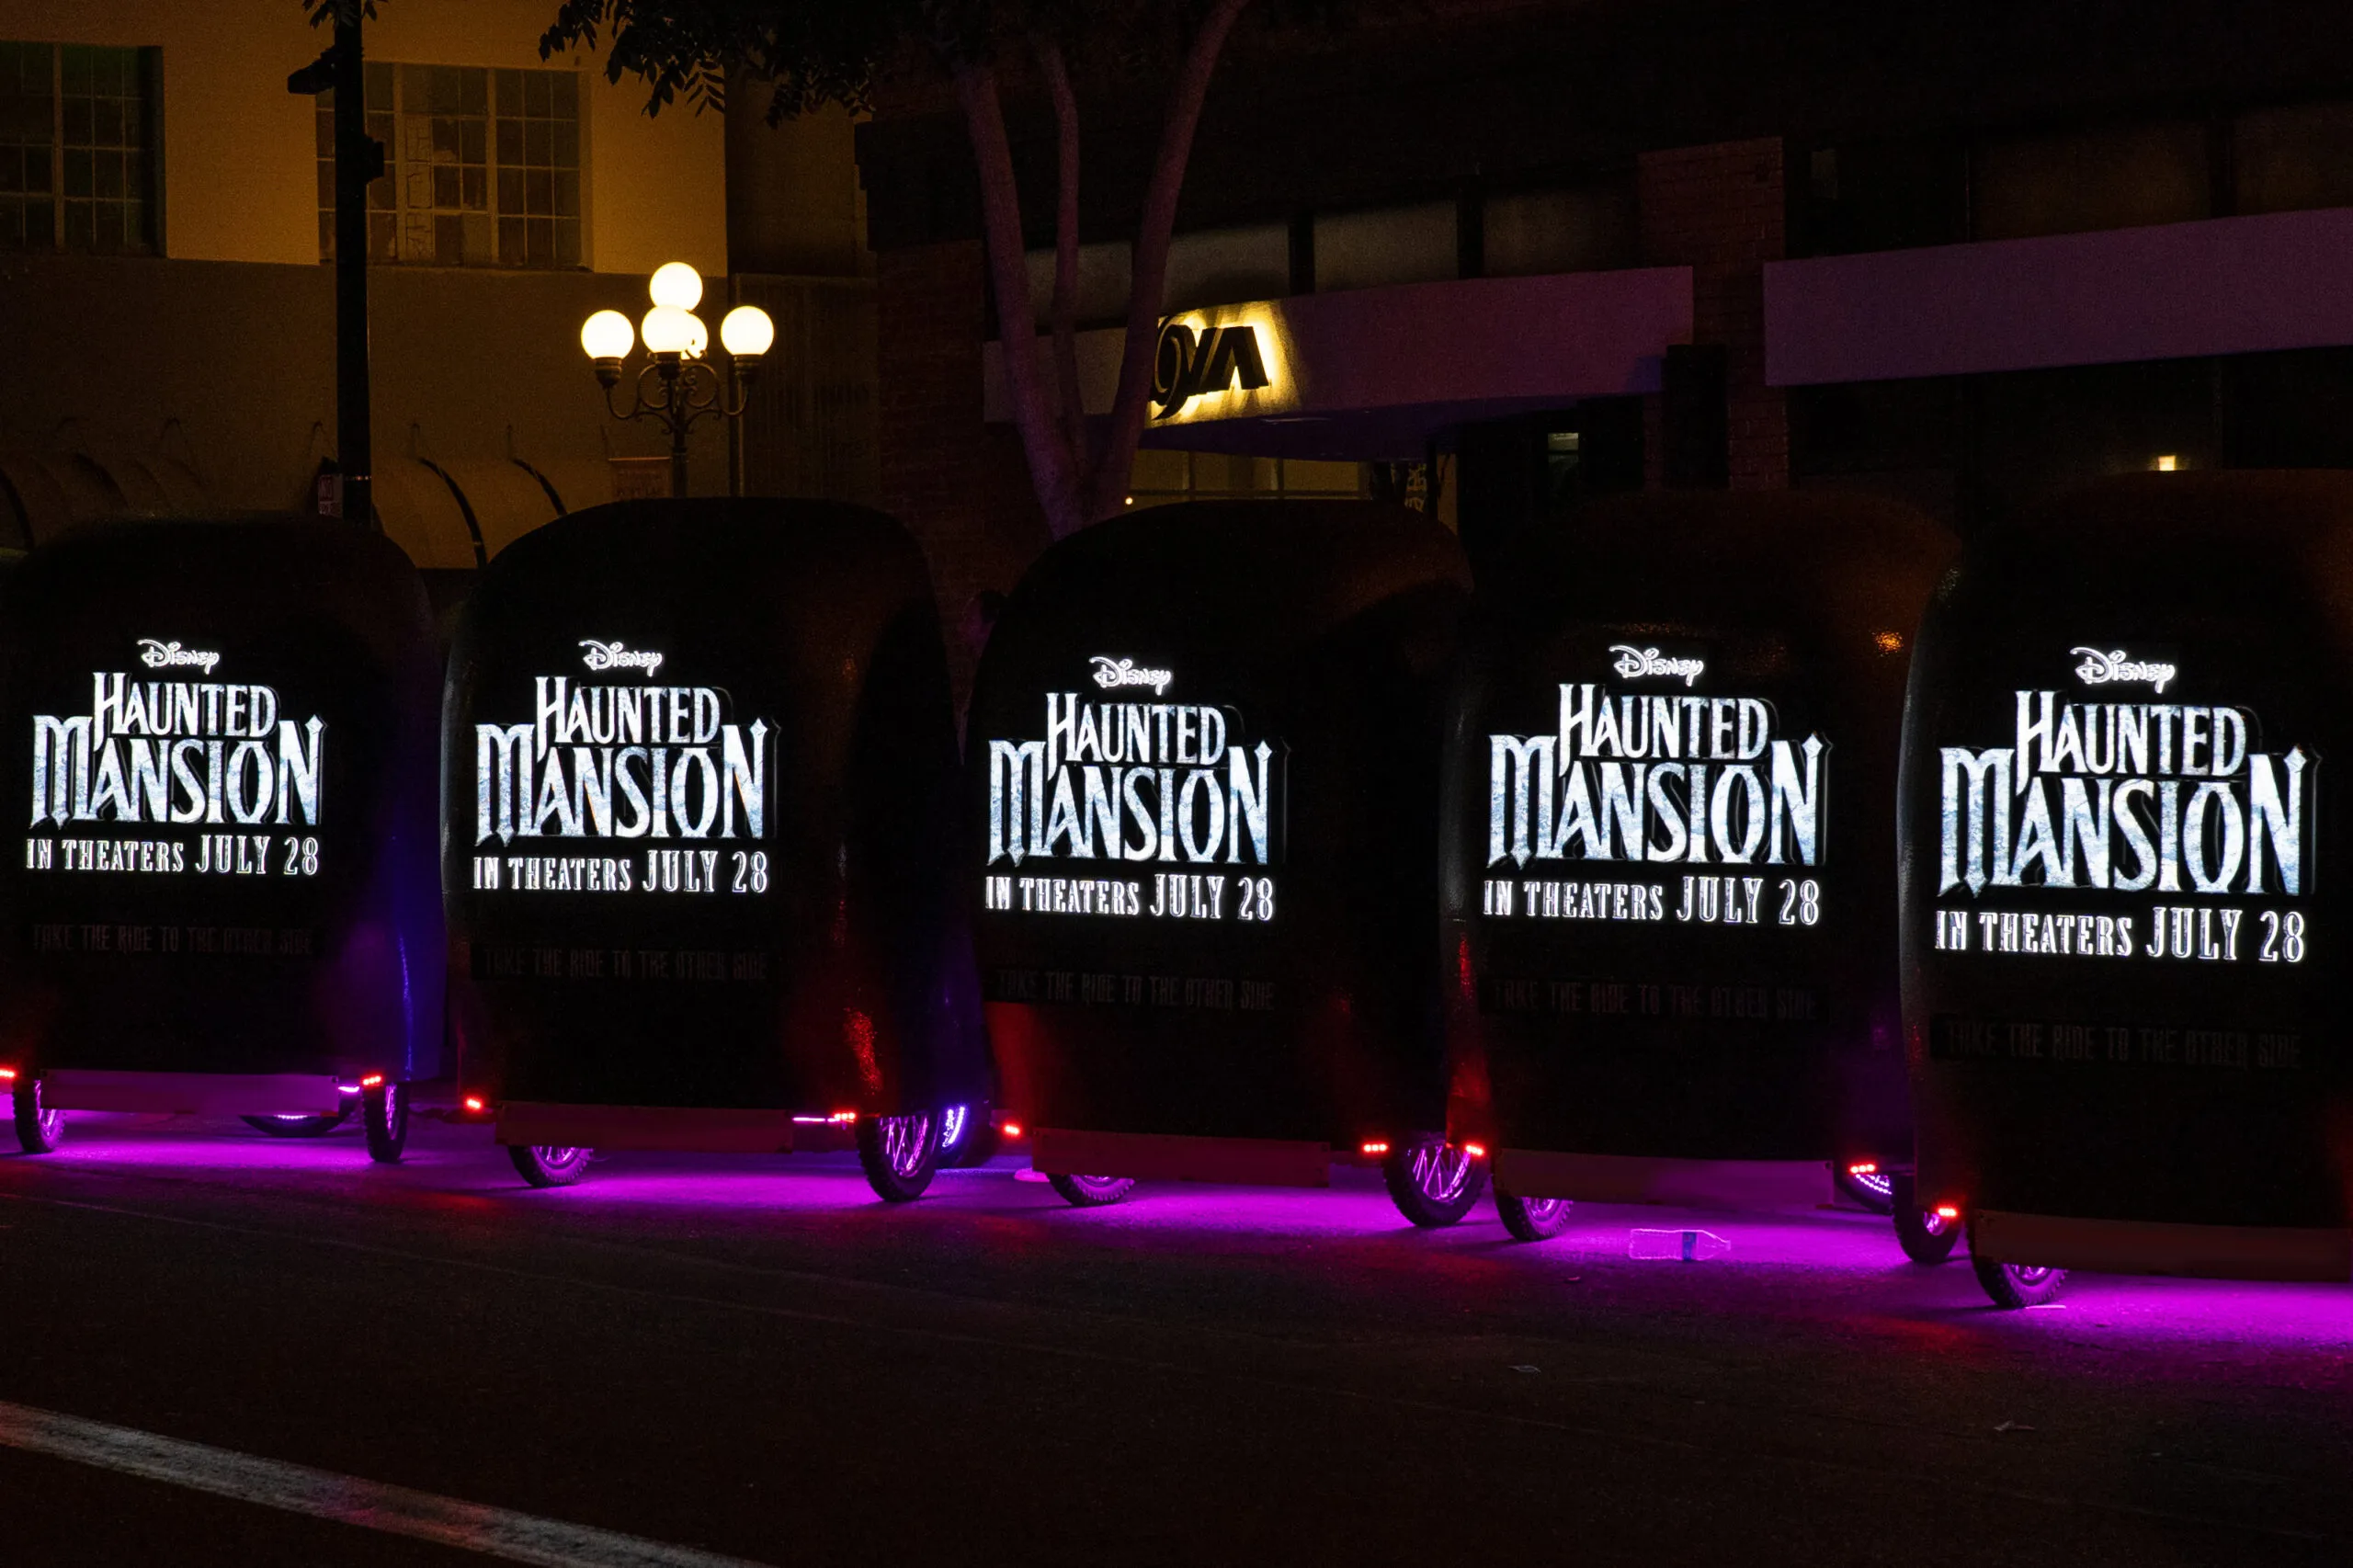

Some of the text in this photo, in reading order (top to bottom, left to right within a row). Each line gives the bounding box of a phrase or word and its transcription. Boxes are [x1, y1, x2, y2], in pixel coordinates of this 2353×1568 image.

[137, 639, 220, 675] Disney
[578, 640, 664, 677] Disney
[1089, 656, 1173, 696] Disney
[1608, 645, 1704, 687] Disney
[2070, 647, 2177, 694] Disney
[93, 672, 276, 752] HAUNTED
[535, 676, 720, 763] HAUNTED
[1046, 692, 1225, 781] HAUNTED
[1559, 684, 1768, 777] HAUNTED
[2016, 690, 2246, 796] HAUNTED
[29, 715, 324, 829] MANSION
[475, 721, 767, 846] MANSION
[986, 740, 1272, 867] MANSION
[1486, 733, 1824, 869] MANSION
[26, 835, 319, 876] IN THEATERS JULY 28
[1937, 746, 2307, 897] MANSION
[472, 849, 768, 894] IN THEATERS JULY 28
[984, 873, 1275, 922] IN THEATERS JULY 28
[1483, 876, 1821, 926] IN THEATERS JULY 28
[1934, 906, 2306, 963] IN THEATERS JULY 28
